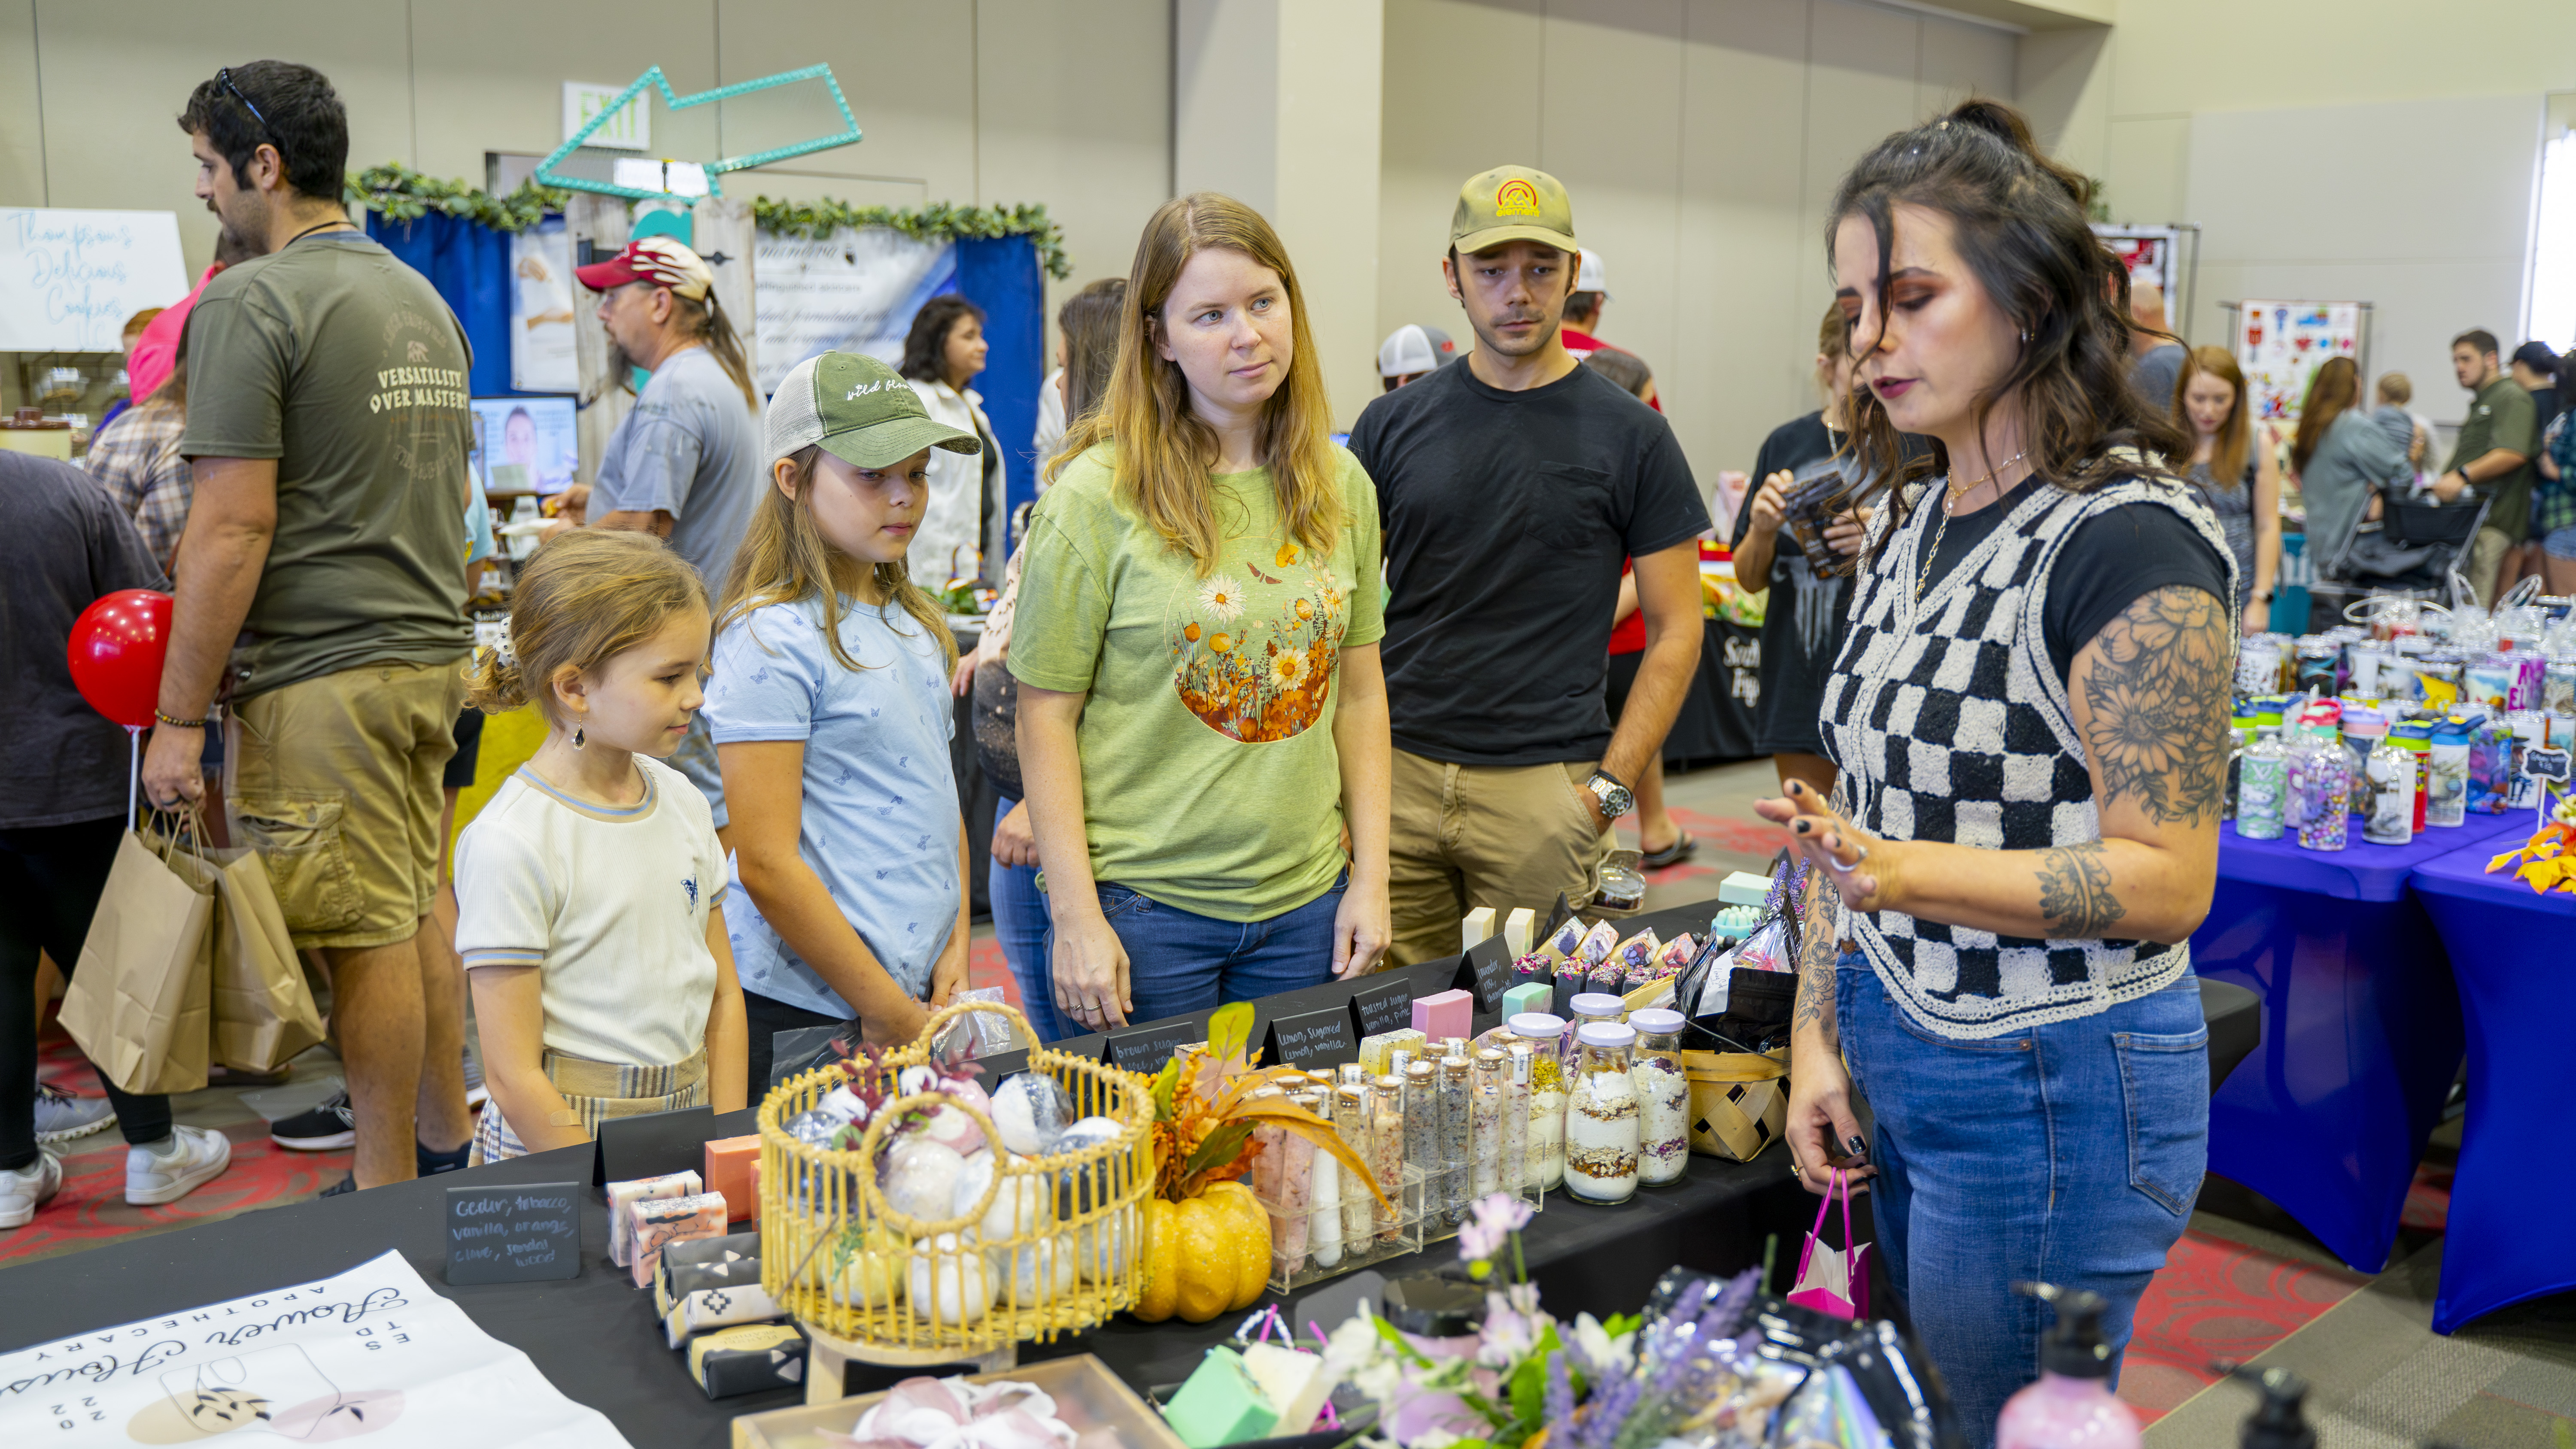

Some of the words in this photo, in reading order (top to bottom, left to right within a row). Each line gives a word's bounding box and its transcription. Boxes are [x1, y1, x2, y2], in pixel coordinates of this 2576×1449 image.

[1496, 207, 1540, 217] element
[377, 366, 462, 389] VERSATILITY
[847, 380, 881, 401] wild
[369, 388, 413, 414] OVER
[1361, 997, 1388, 1016] toasted
[1366, 1015, 1393, 1032] vanilla,
[1115, 1043, 1150, 1059] brown
[205, 1287, 409, 1346] Flower
